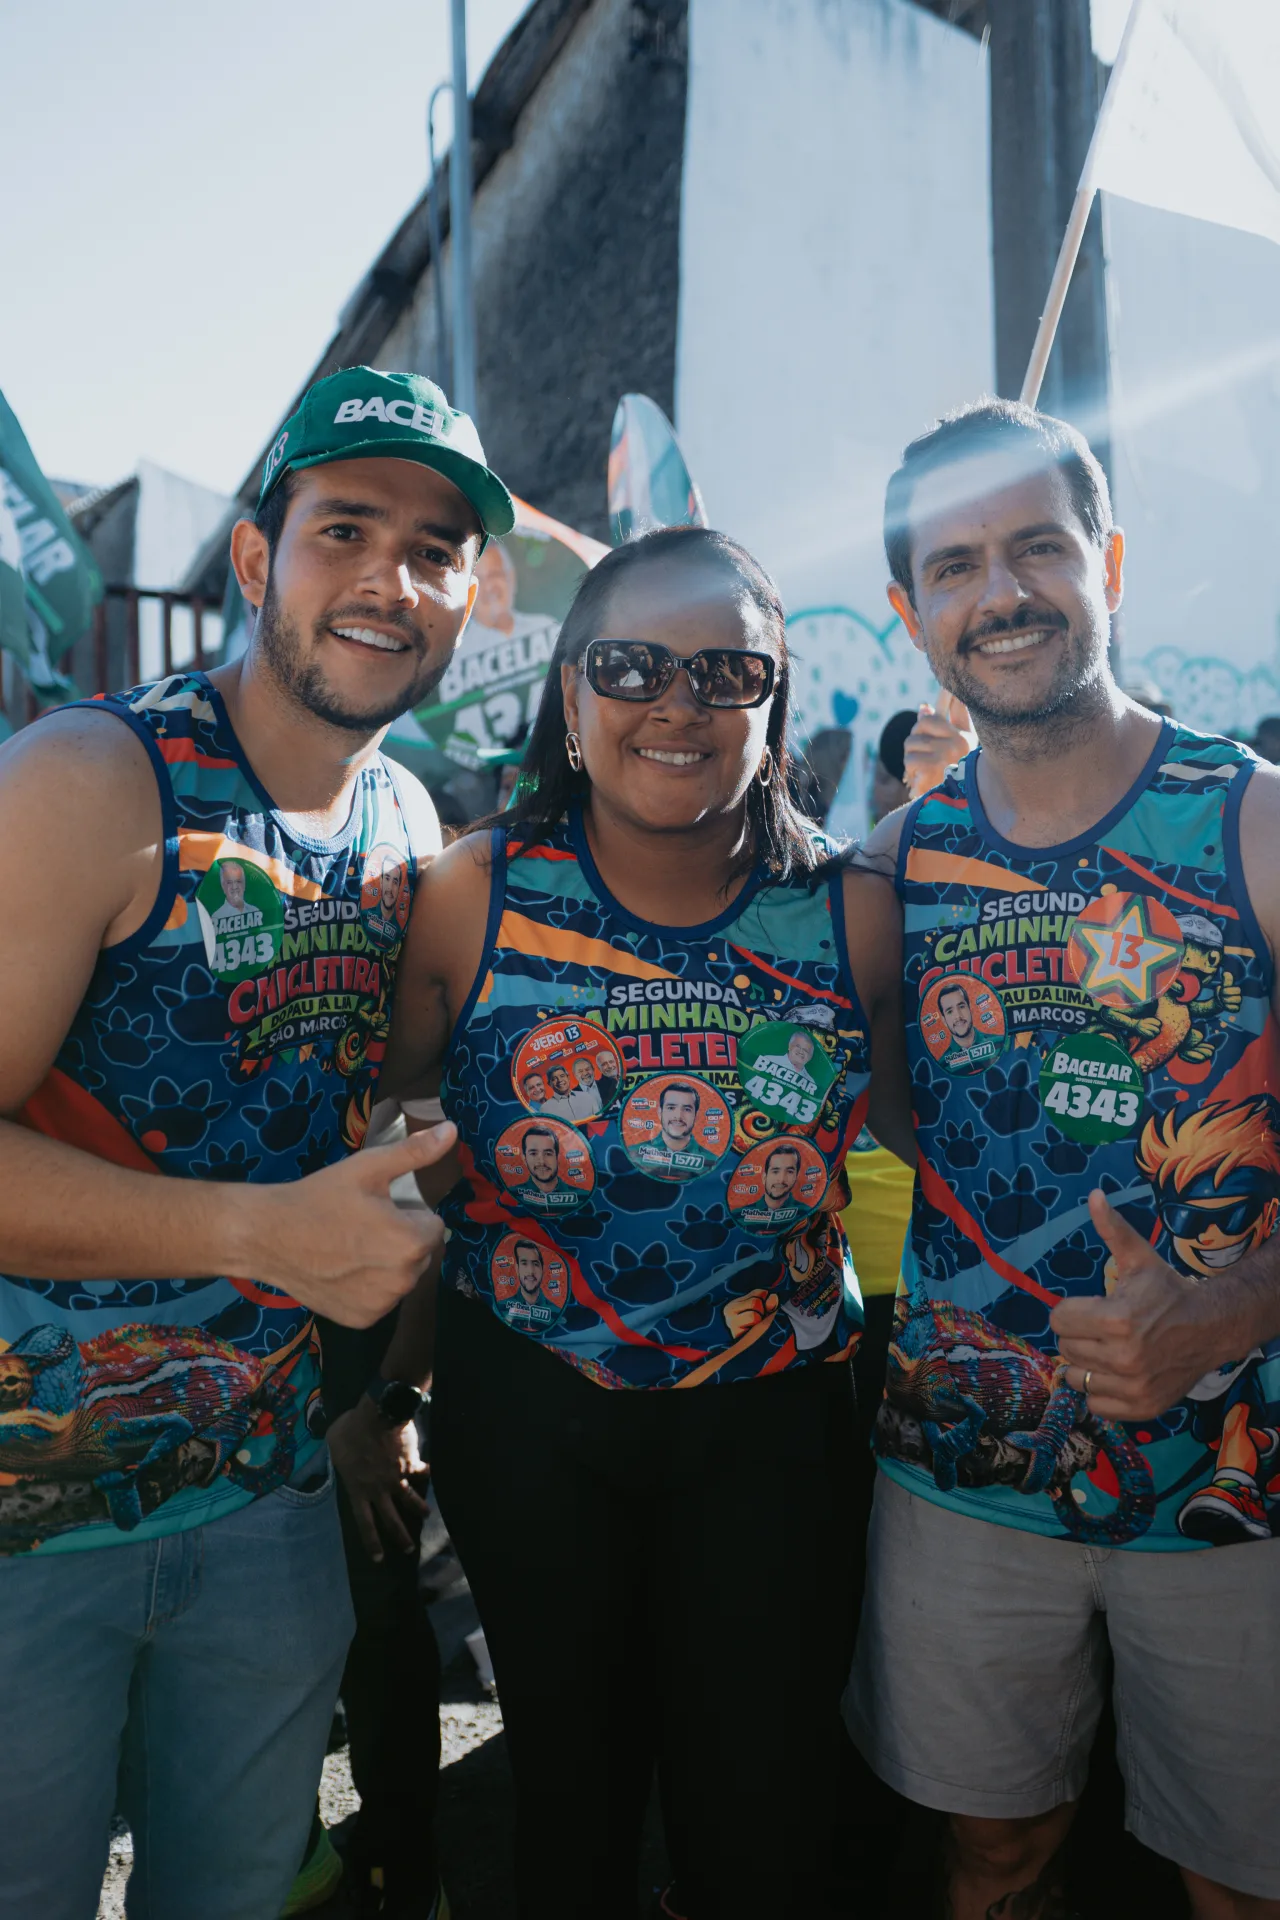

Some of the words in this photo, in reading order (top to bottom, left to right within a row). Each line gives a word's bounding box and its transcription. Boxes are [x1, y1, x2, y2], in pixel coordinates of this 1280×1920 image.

[334, 397, 449, 438] BACEL
[210, 932, 275, 973] 4343
[935, 915, 1078, 962] CAMINH
[1109, 931, 1145, 970] 13
[609, 981, 742, 1008] SEGUNDA
[1000, 989, 1025, 1004] AU
[1028, 987, 1052, 1002] DA
[1059, 989, 1095, 1008] LIMA
[585, 1002, 768, 1034] AMINHAD
[1013, 1006, 1087, 1026] MARCOS
[566, 1026, 580, 1040] 13
[752, 1054, 818, 1096] BACELAR
[1052, 1051, 1133, 1083] BACELAR
[744, 1075, 818, 1123] 4343
[1044, 1081, 1140, 1127] 4343
[639, 1147, 672, 1158] Matheus
[674, 1154, 702, 1167] 15777
[549, 1194, 576, 1204] 15777
[741, 1208, 772, 1217] Matheus
[774, 1209, 796, 1220] 15777
